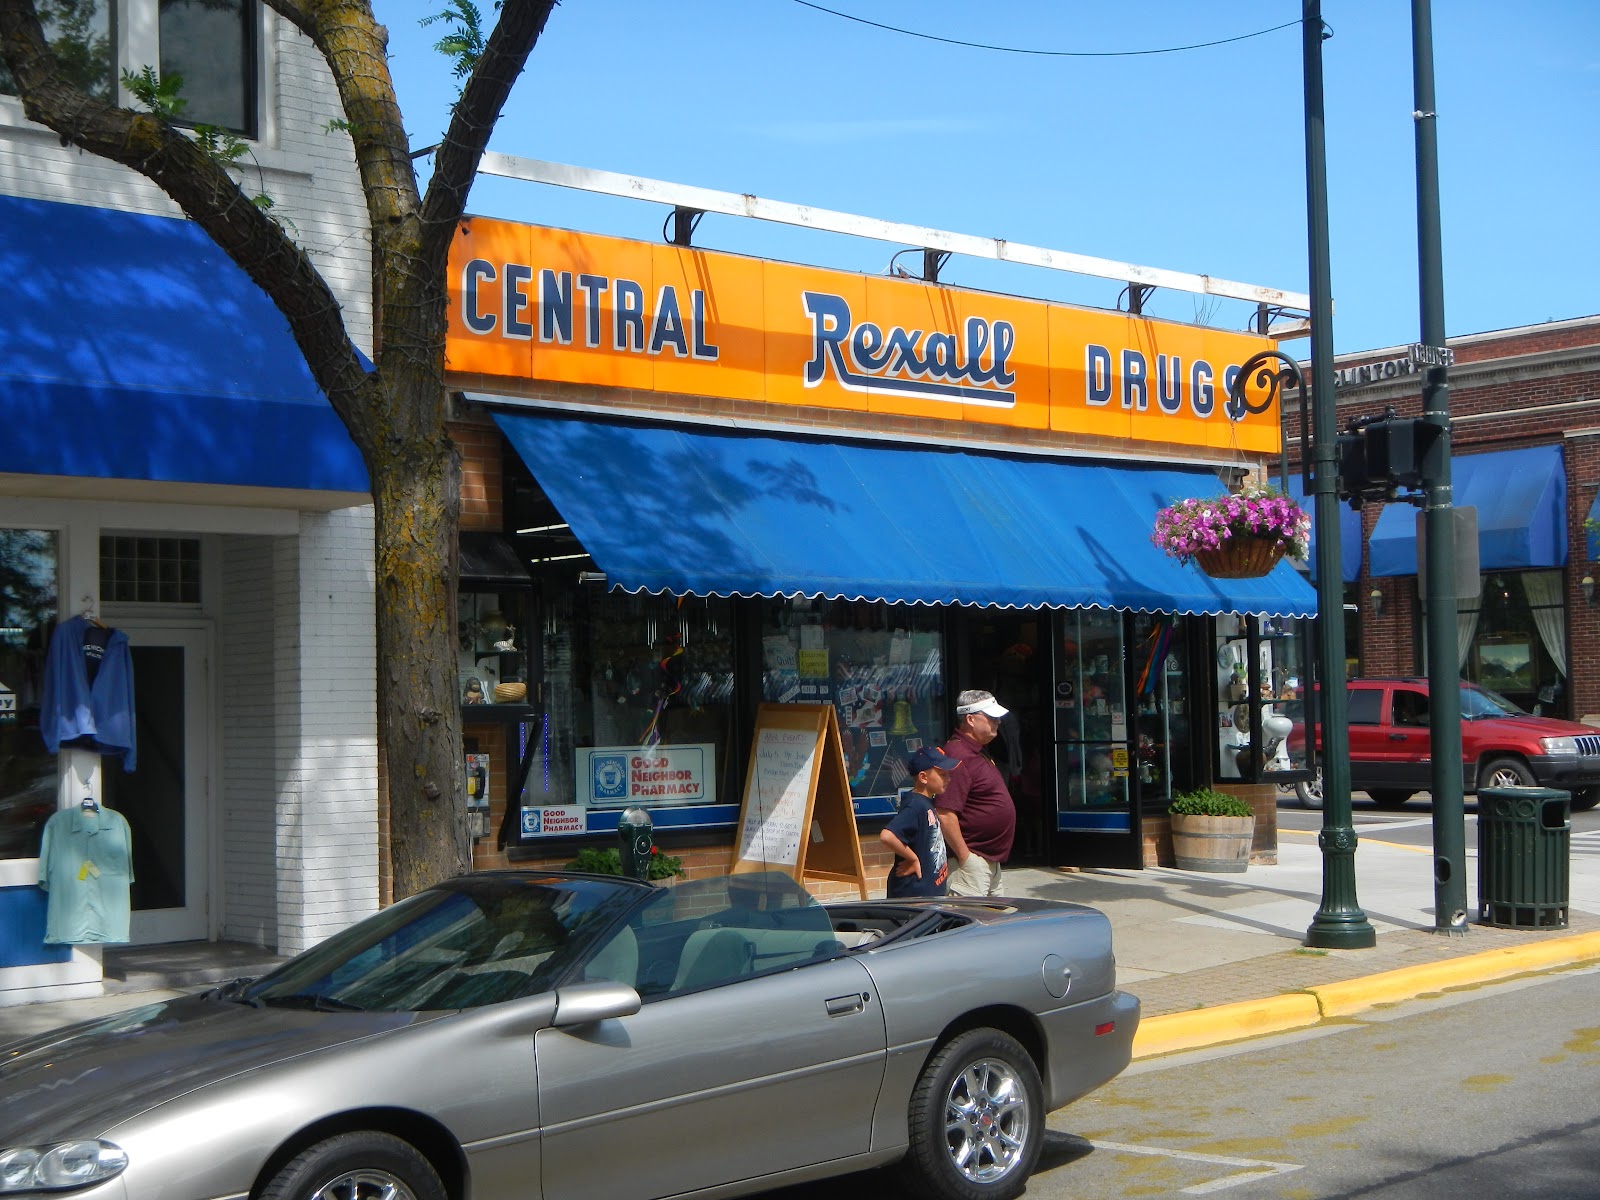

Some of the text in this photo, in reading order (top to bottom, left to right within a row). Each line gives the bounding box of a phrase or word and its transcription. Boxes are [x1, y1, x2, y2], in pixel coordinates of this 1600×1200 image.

[461, 258, 1247, 422] CENTRAL Rexall DRUGS
[631, 756, 669, 768] GOOD
[631, 769, 692, 782] NEIGHBOR
[631, 782, 700, 796] PHARMACY
[543, 824, 583, 832] PHARMACY
